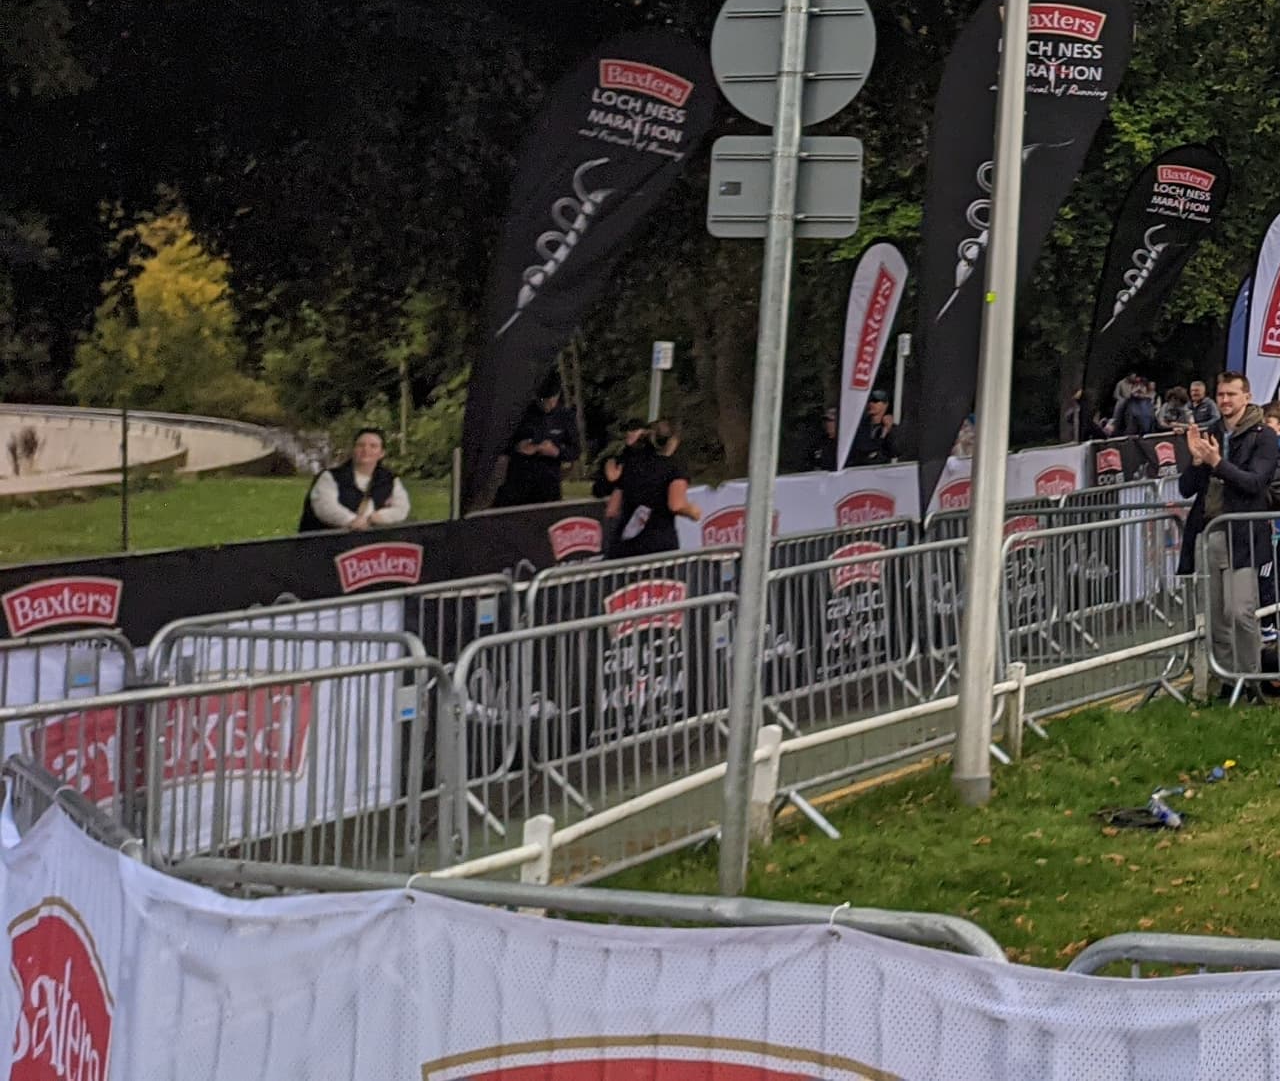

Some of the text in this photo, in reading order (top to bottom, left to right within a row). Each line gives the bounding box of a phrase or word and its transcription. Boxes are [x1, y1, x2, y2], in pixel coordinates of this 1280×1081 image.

[1028, 10, 1097, 34] axters
[1058, 43, 1104, 59] NESS
[607, 65, 684, 100] Baxters
[591, 87, 687, 124] LOCH NESS
[1153, 183, 1211, 201] LOCH NESS
[855, 277, 892, 382] Baxters
[344, 552, 417, 583] Baxters
[14, 586, 113, 627] Baxters
